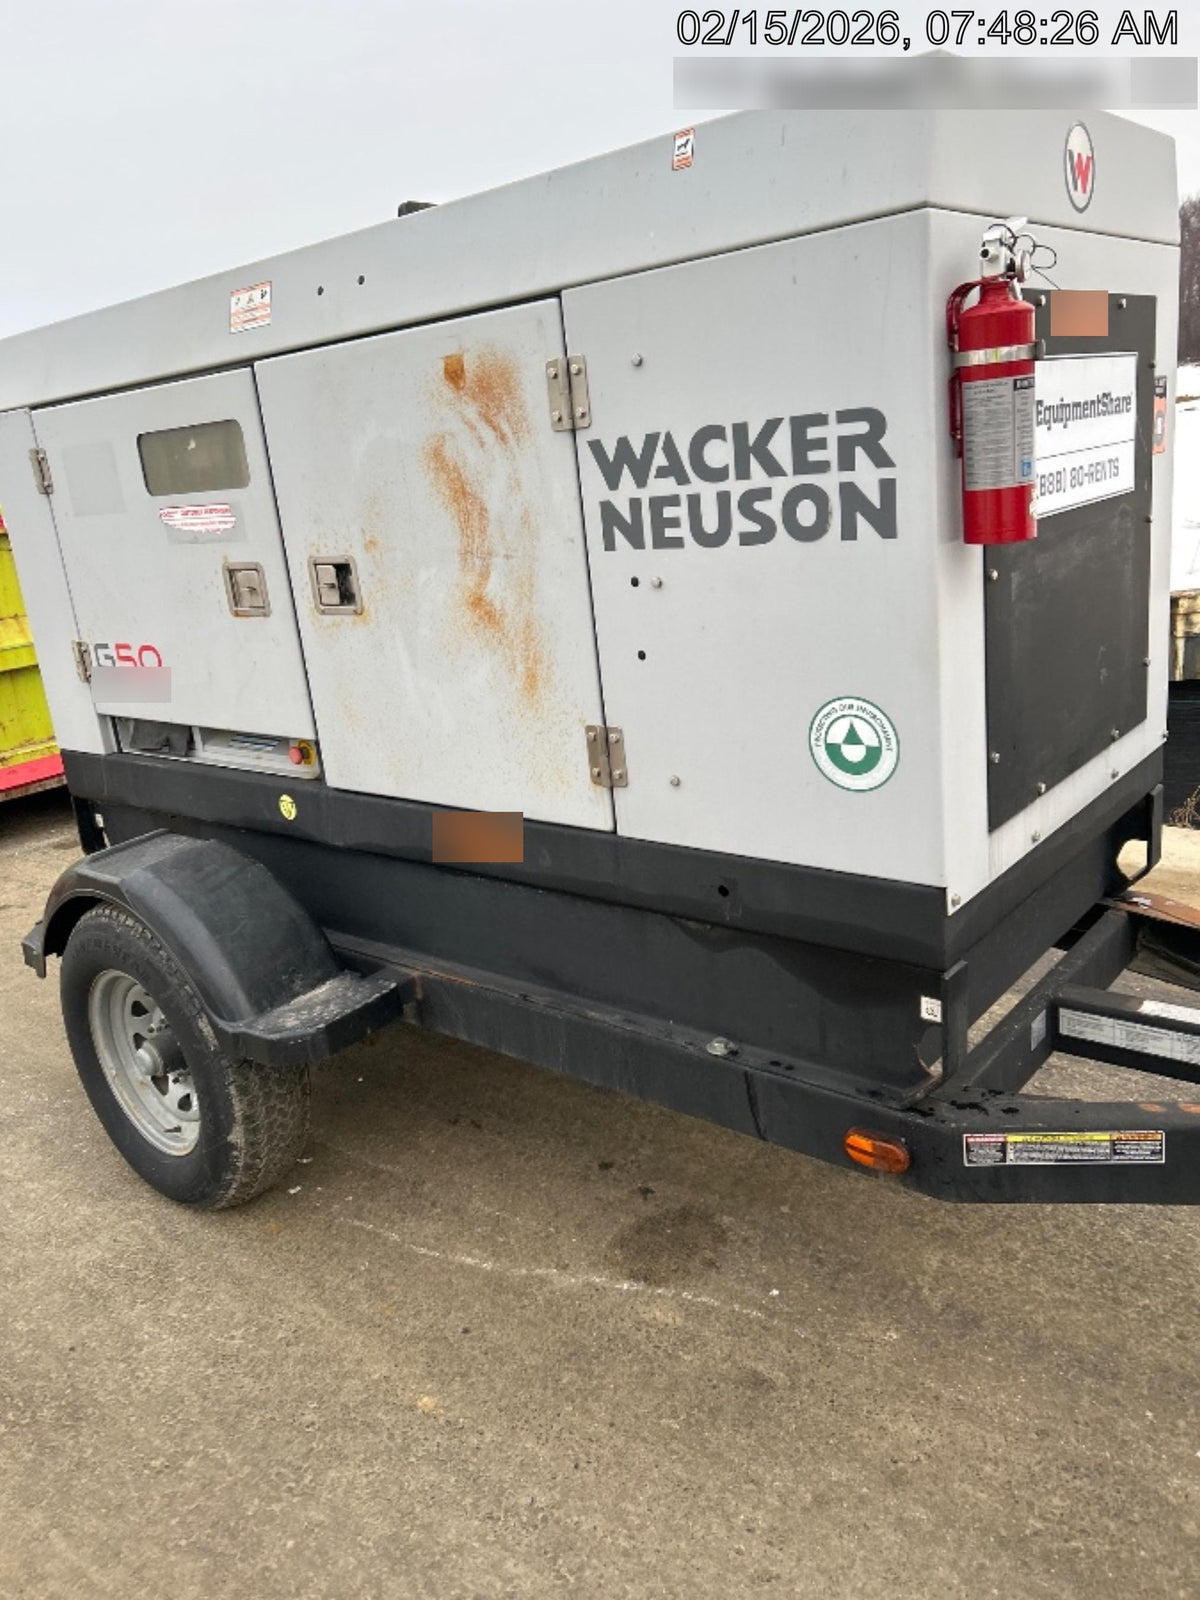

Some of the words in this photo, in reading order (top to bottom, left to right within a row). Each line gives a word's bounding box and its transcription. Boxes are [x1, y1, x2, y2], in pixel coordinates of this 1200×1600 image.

[1036, 392, 1132, 431] EquipmentShare
[586, 407, 897, 491] WACKER
[599, 478, 898, 552] NEUSON
